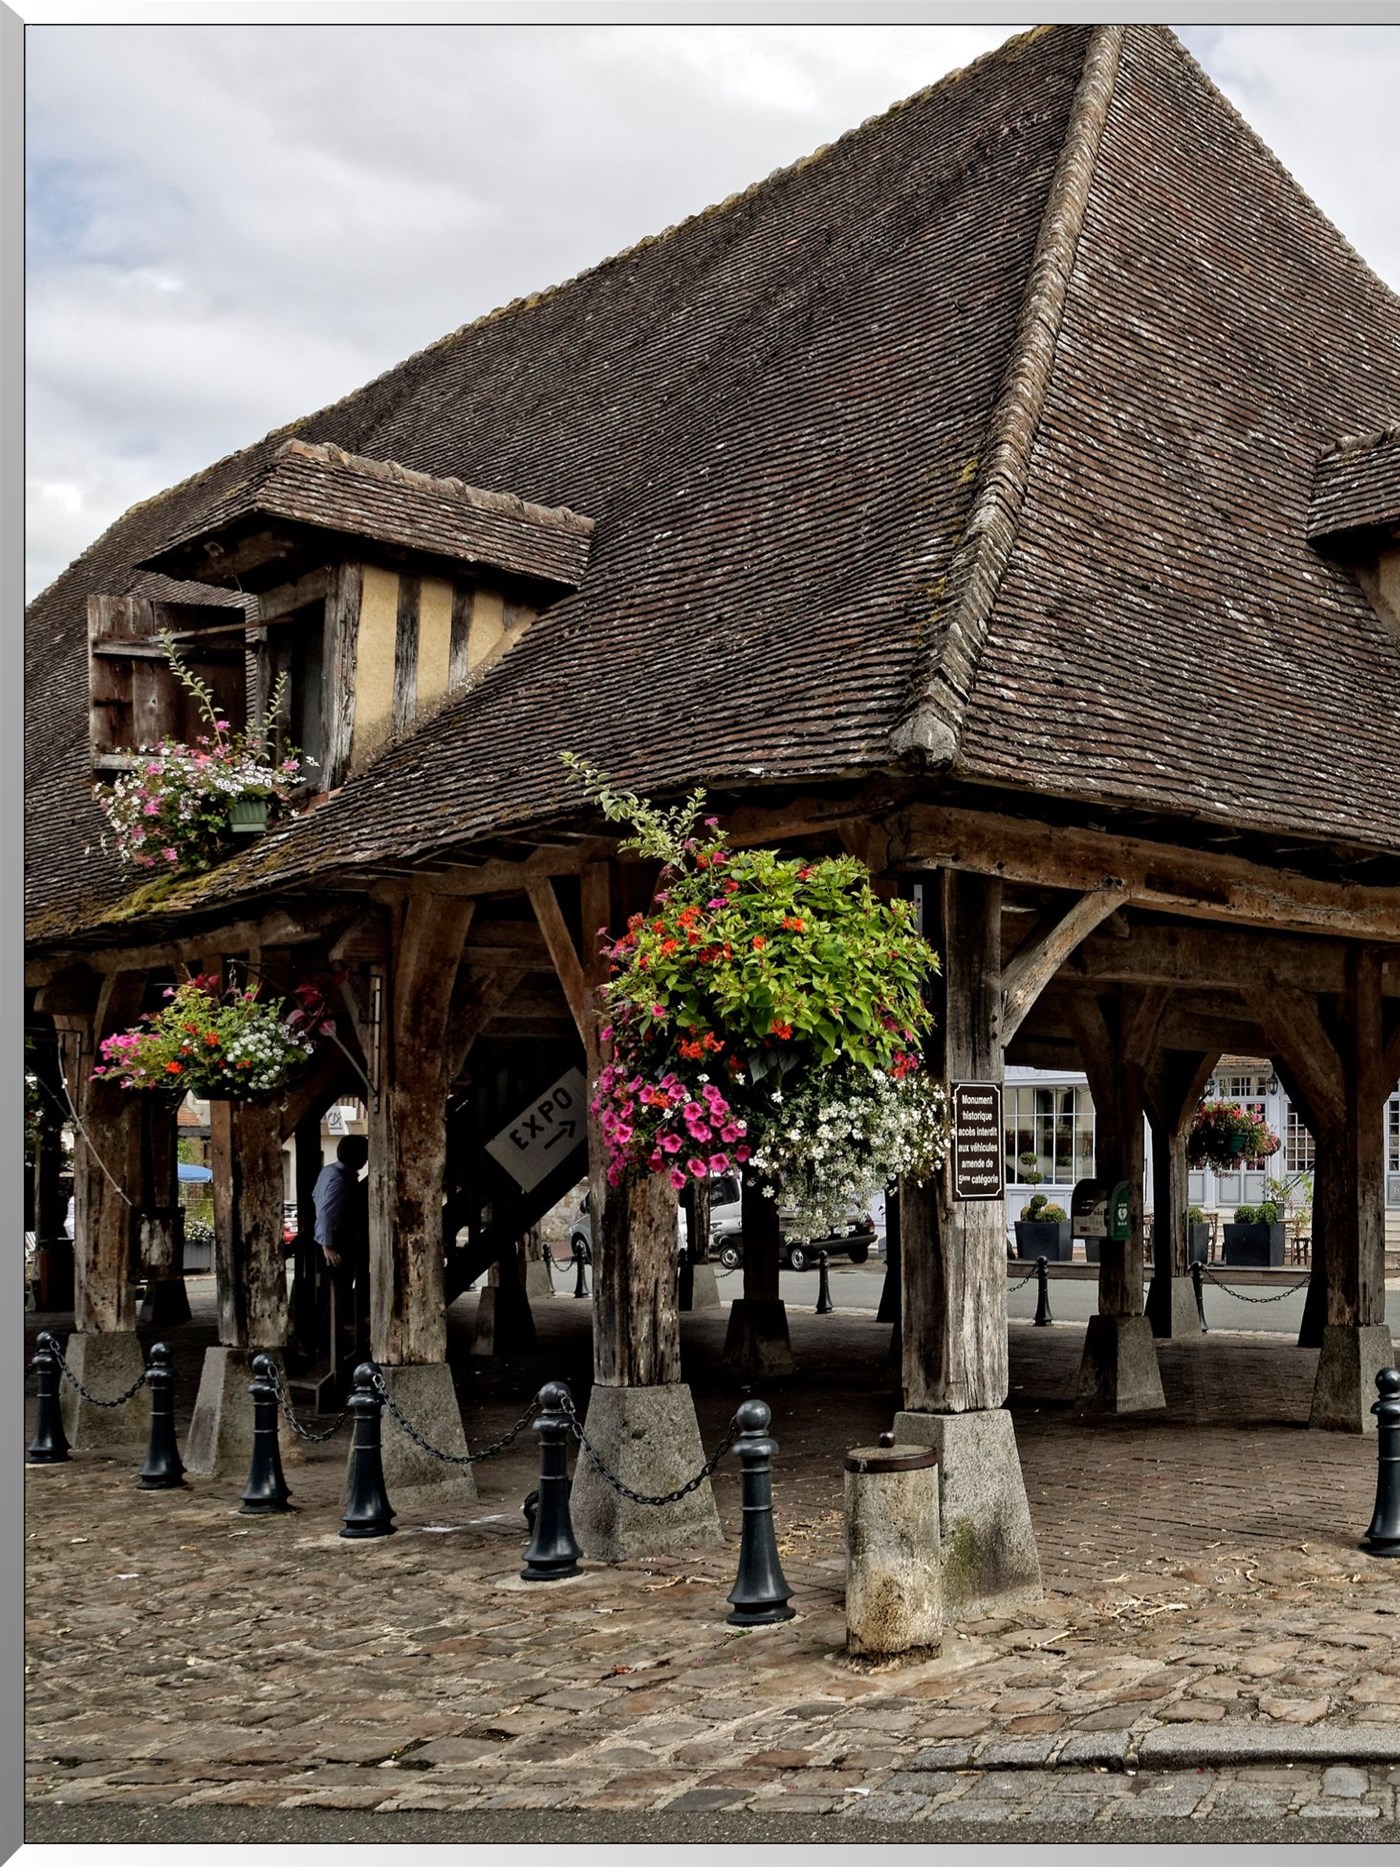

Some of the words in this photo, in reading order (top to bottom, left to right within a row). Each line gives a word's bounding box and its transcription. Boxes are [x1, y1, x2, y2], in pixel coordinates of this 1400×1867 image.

[961, 1094, 993, 1105] Monument
[509, 1087, 573, 1151] EXPO
[962, 1110, 993, 1123] historique
[958, 1126, 976, 1137] accès
[976, 1126, 998, 1137] interdit
[958, 1144, 970, 1153] aux
[970, 1142, 998, 1153] véhicules
[961, 1158, 985, 1168] amende
[985, 1158, 994, 1168] de
[971, 1173, 999, 1186] catégorie
